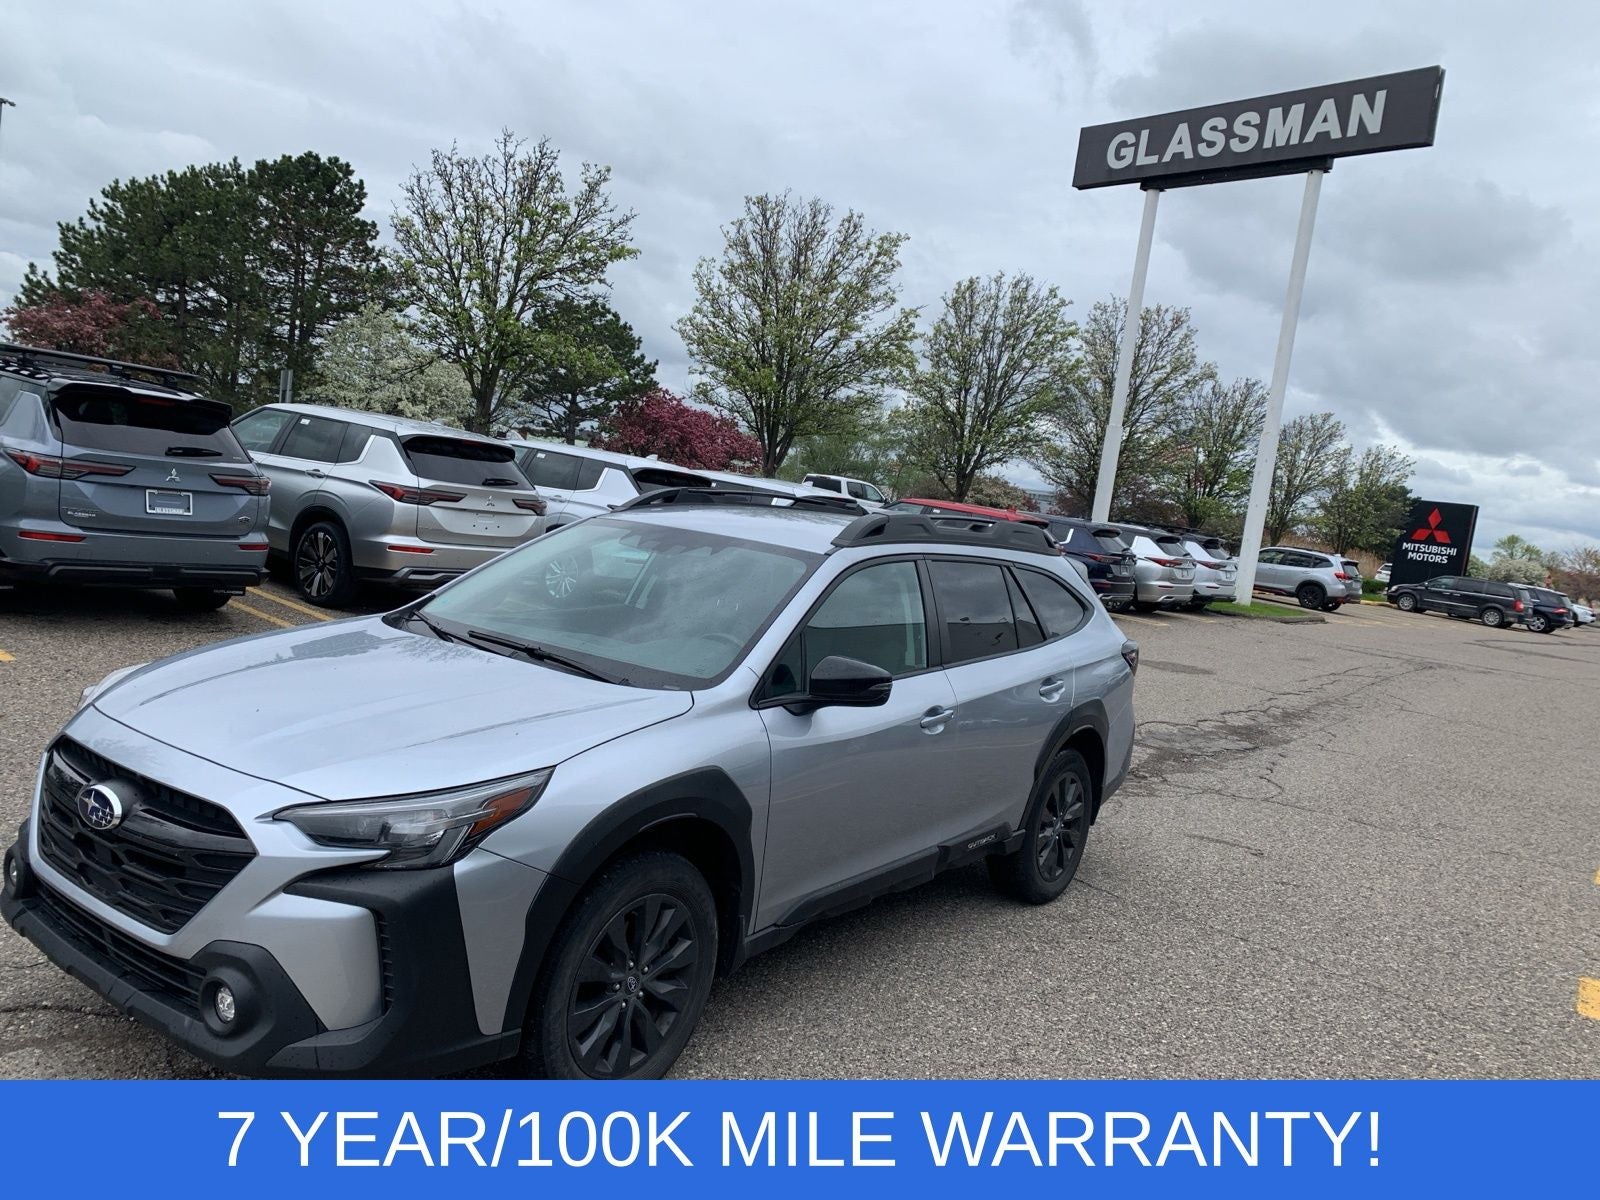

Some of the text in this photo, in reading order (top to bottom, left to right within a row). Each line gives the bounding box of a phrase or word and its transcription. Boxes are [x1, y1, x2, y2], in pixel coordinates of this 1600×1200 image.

[1106, 89, 1388, 170] GLASSMAN
[1402, 542, 1458, 556] MITSUBISHI
[1407, 551, 1449, 564] MOTORS
